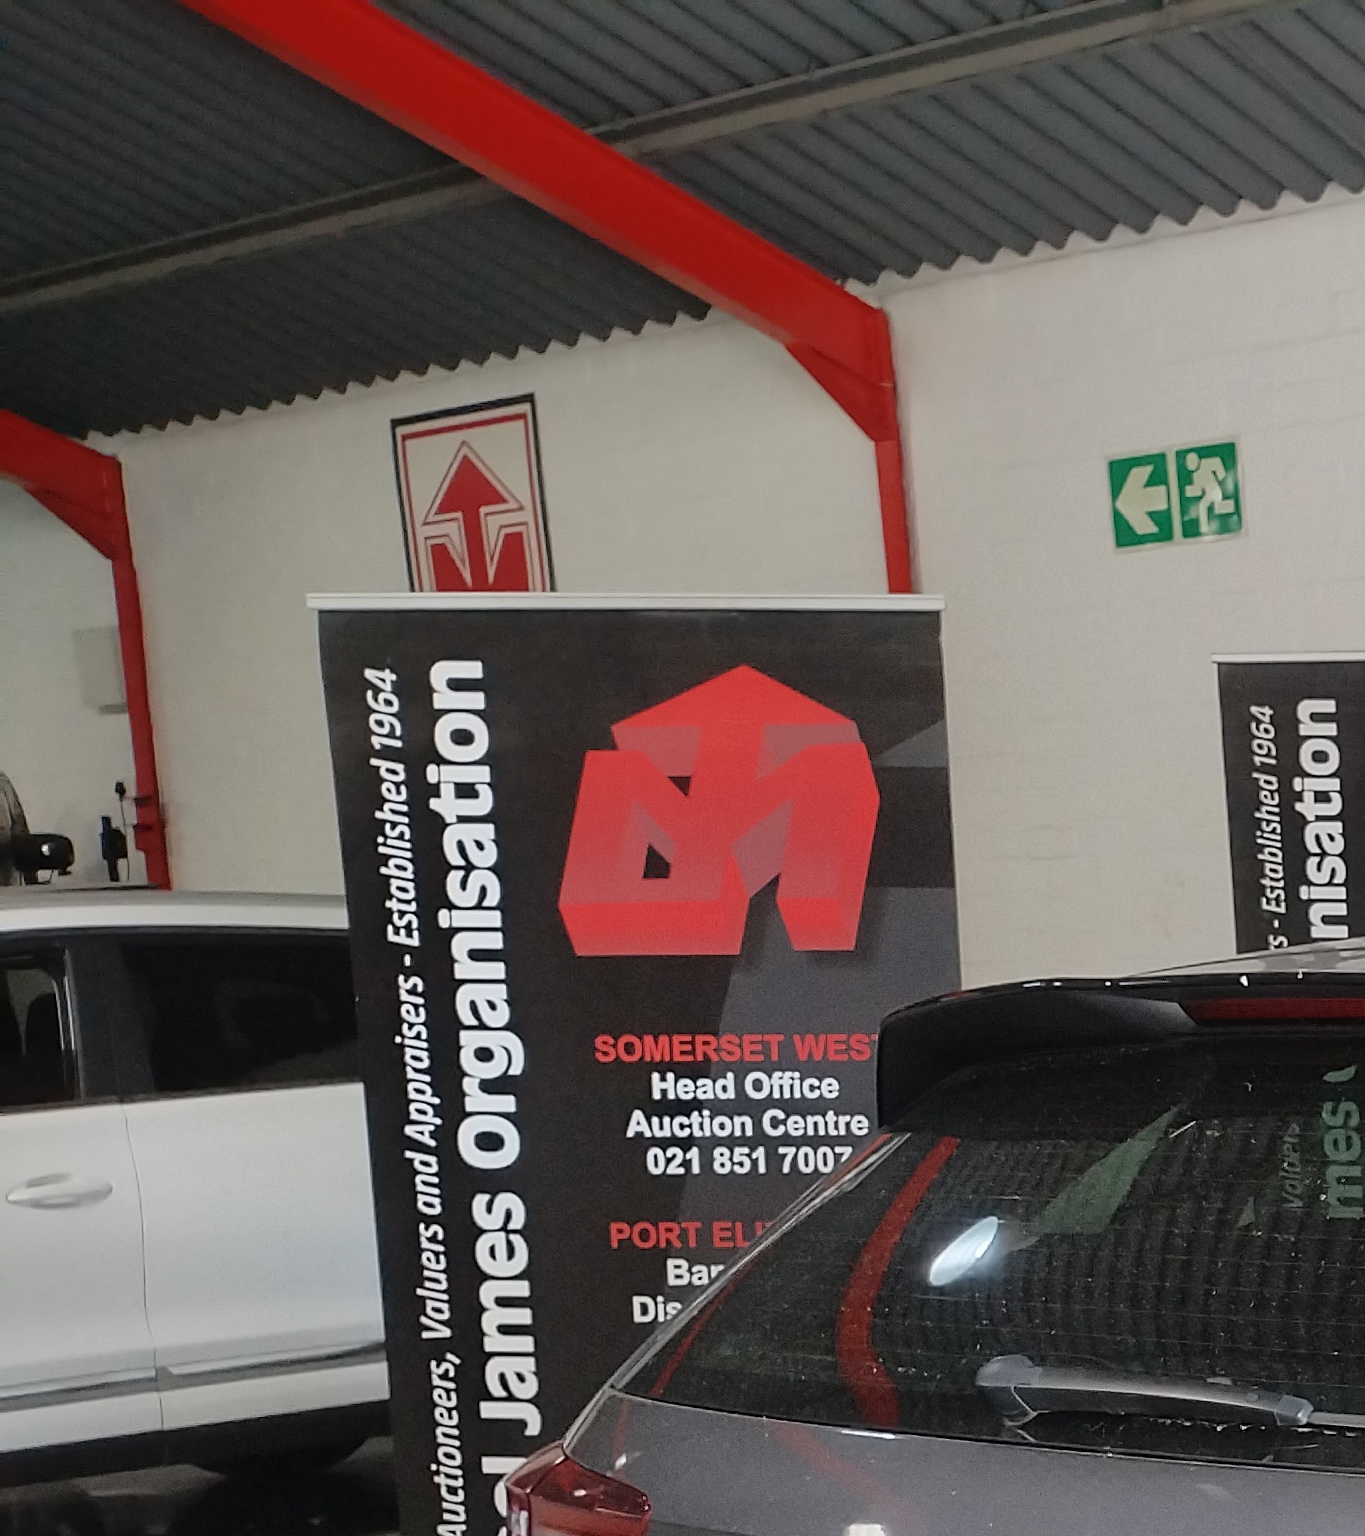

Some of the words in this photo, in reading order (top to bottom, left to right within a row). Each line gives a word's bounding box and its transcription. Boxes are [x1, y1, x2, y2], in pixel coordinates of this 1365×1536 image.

[363, 667, 404, 750] 1964
[1249, 705, 1277, 766] 1964
[369, 758, 422, 947] Established
[1251, 772, 1287, 914] Established
[1293, 699, 1349, 938] nisation
[425, 660, 525, 1169] Organisation
[395, 975, 442, 1146] Appraisers
[594, 1034, 784, 1063] SOMERSET
[651, 1072, 736, 1100] Head
[745, 1072, 840, 1100] Office
[626, 1109, 754, 1138] Auction
[762, 1109, 869, 1137] Centre
[646, 1147, 701, 1176] 021
[713, 1147, 767, 1175] 851
[1321, 1101, 1365, 1219] mes
[403, 1151, 442, 1214] and
[415, 1223, 454, 1339] Valuers
[610, 1222, 703, 1249] PORT
[470, 1192, 544, 1436] James
